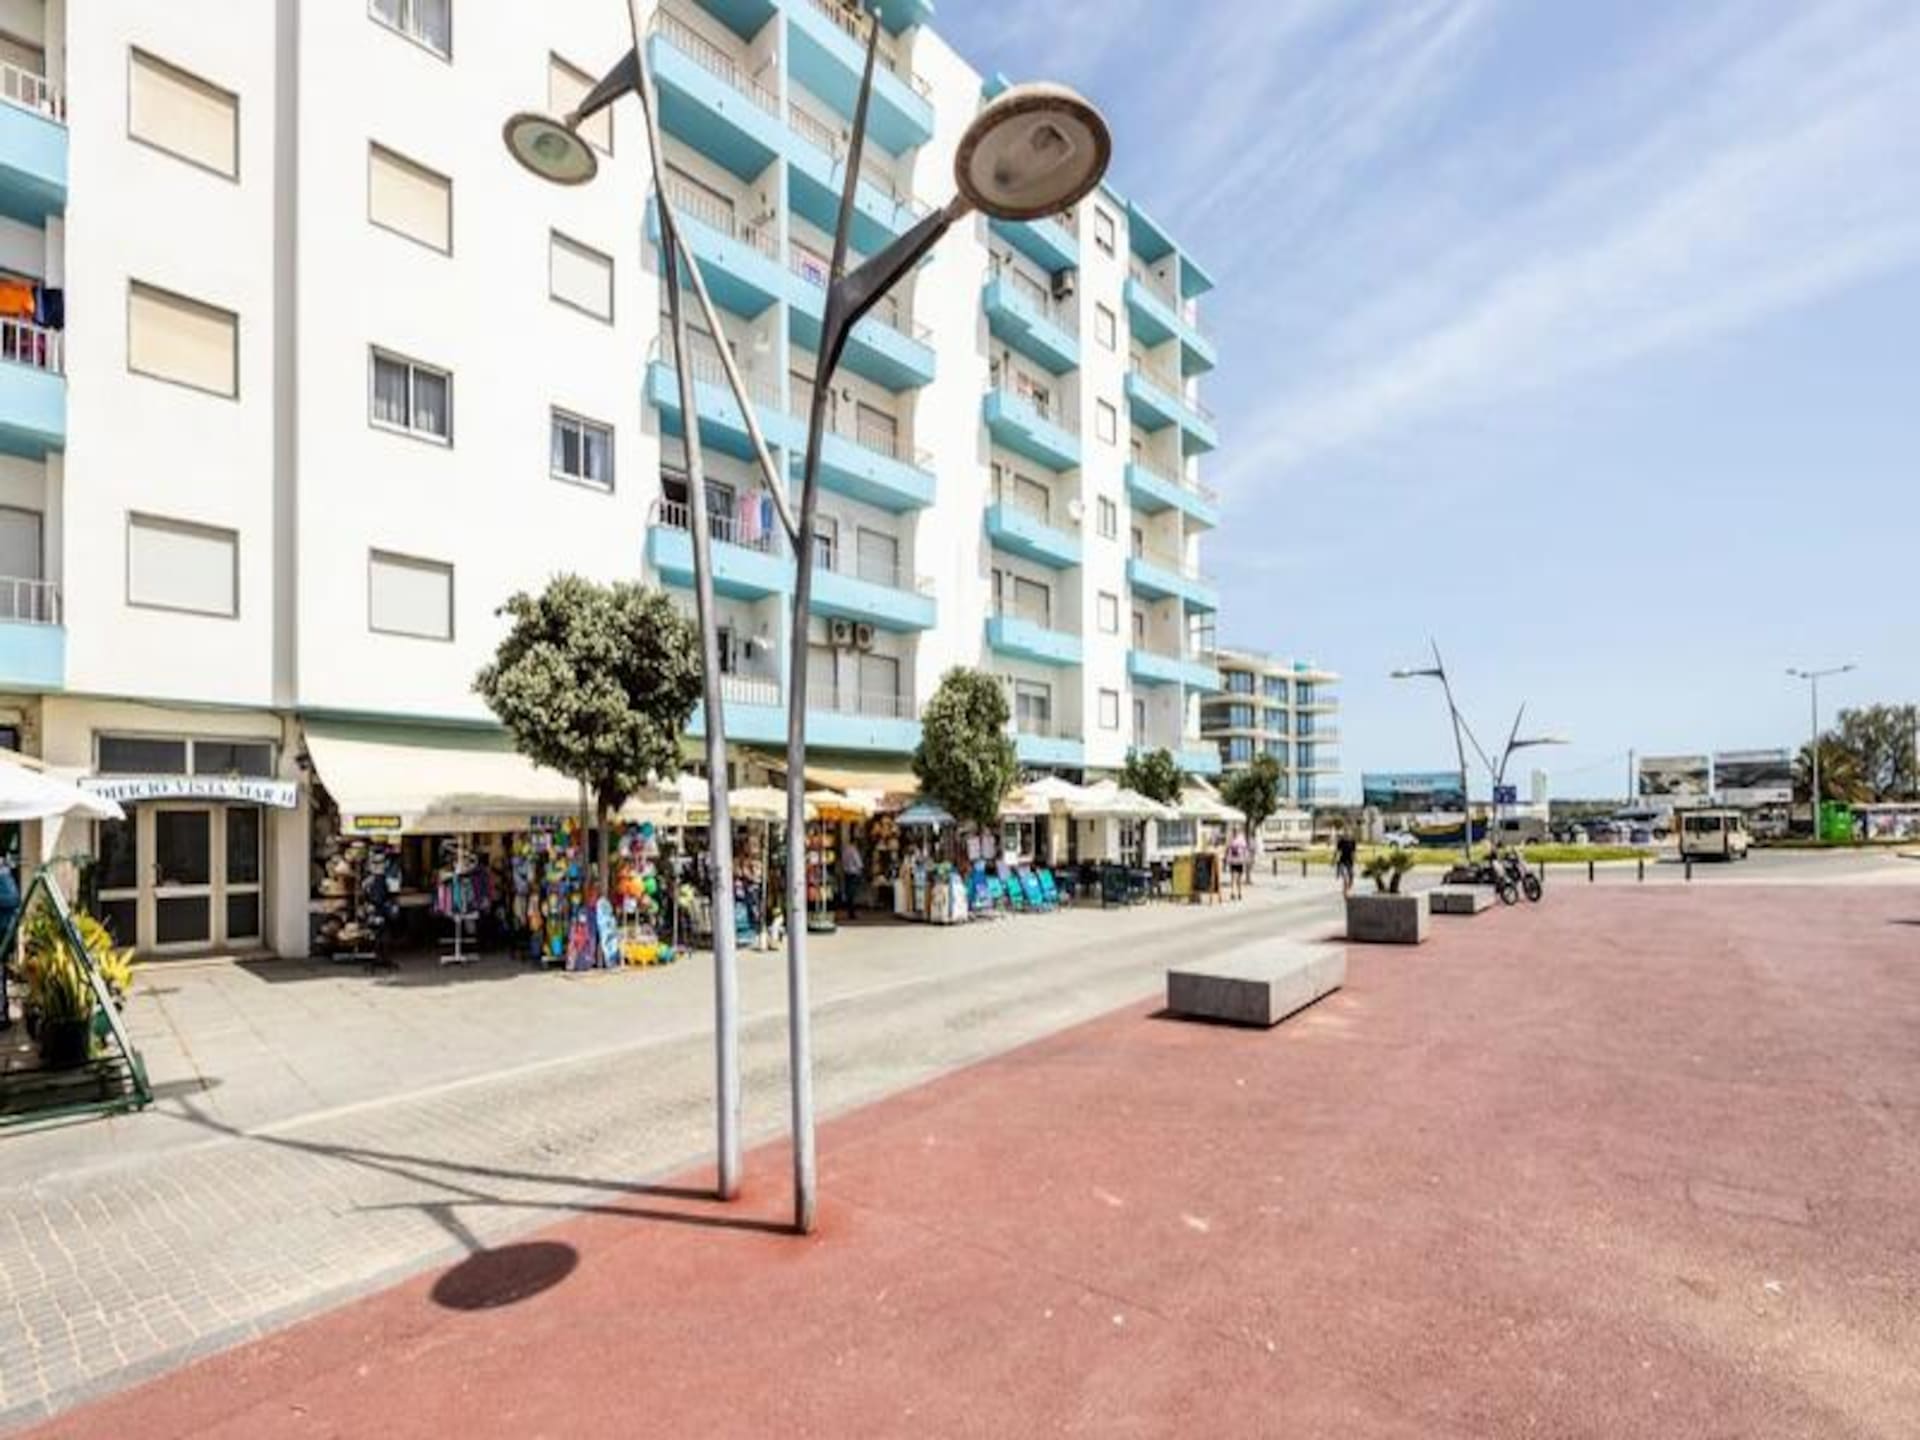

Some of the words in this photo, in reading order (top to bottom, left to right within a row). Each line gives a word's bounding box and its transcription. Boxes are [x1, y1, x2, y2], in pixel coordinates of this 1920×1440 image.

[95, 781, 169, 799] DIFICIO
[177, 779, 226, 793] VISTA
[239, 784, 276, 800] MAR
